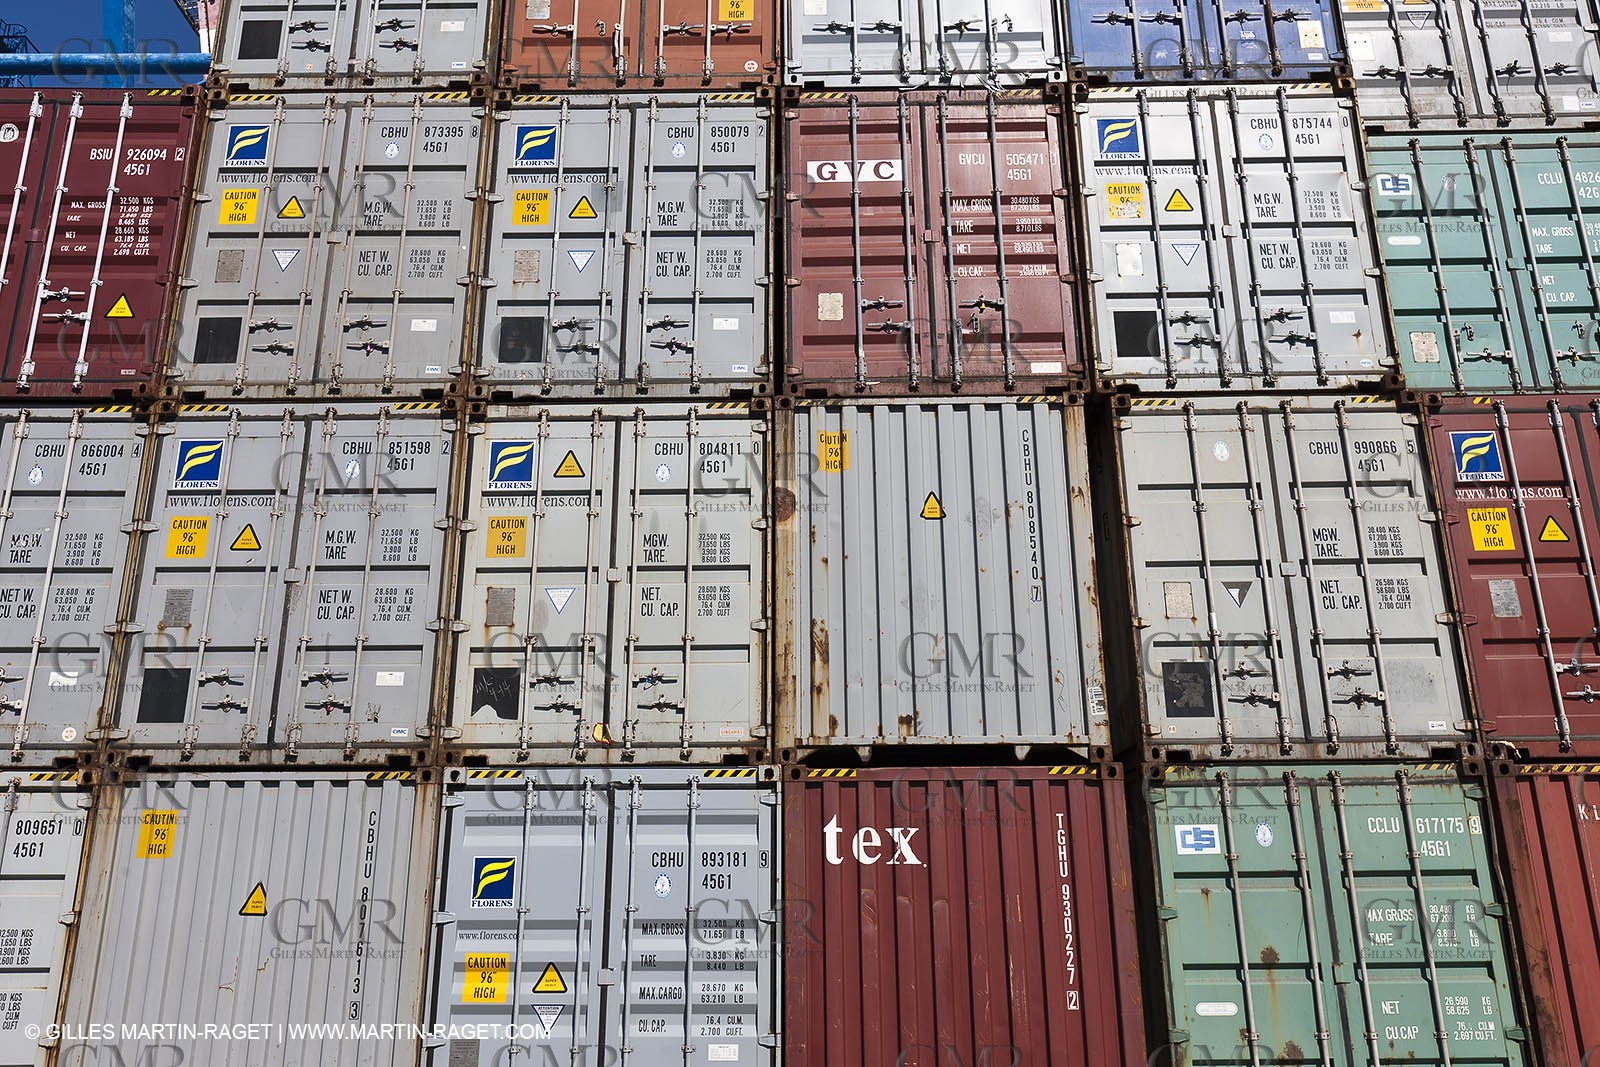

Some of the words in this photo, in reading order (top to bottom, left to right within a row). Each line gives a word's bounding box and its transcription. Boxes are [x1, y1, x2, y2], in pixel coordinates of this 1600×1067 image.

[1250, 119, 1278, 130] CBHU
[1292, 118, 1332, 129] 875744
[381, 127, 408, 138] CBHU
[424, 127, 464, 137] 873395
[668, 127, 693, 138] CBHU
[711, 126, 749, 137] 850079
[1296, 134, 1320, 144] 45G1
[423, 142, 448, 152] 45G1
[711, 142, 735, 153] 45G1
[90, 149, 112, 160] BSIU
[126, 149, 167, 160] 926094
[176, 148, 184, 161] 2
[959, 153, 985, 165] GVCU
[1006, 154, 1044, 165] 505471
[124, 164, 150, 175] 45G1
[816, 162, 895, 180] GVC
[1007, 169, 1032, 180] 45G1
[1538, 173, 1562, 184] CCLU
[225, 192, 256, 200] CAUTION
[1108, 186, 1140, 195] CAUTION
[516, 193, 548, 201] CAUTION
[1254, 193, 1283, 204] M.G.W.
[364, 202, 392, 213] M.G.W.
[658, 202, 685, 213] M.G.W.
[971, 199, 992, 211] GROSS
[229, 213, 246, 221] HIGH
[522, 214, 539, 223] HIGH
[1256, 207, 1277, 218] TARE
[364, 215, 383, 226] TARE
[658, 215, 677, 226] TARE
[956, 220, 973, 233] TARE
[957, 244, 971, 254] NET
[1260, 244, 1278, 256] NET
[1280, 244, 1292, 256] W.
[1536, 245, 1552, 253] TARE
[359, 251, 379, 262] NET
[379, 251, 390, 262] W.
[657, 252, 675, 263] NET
[676, 252, 687, 263] W.
[1542, 276, 1554, 285] NET
[35, 445, 65, 457] CBHU
[81, 445, 124, 457] 866004
[133, 444, 140, 457] 4
[343, 442, 371, 454] CBHU
[389, 441, 430, 454] 851598
[442, 440, 449, 454] 2
[654, 443, 683, 455] CBHU
[699, 442, 741, 455] 804811
[1309, 442, 1338, 455] CBHU
[1354, 441, 1397, 453] 990866
[79, 463, 107, 475] 45G1
[387, 459, 415, 470] 45G1
[700, 461, 727, 473] 45G1
[1358, 459, 1385, 472] 45G1
[1022, 430, 1032, 485] CBHU
[1027, 491, 1038, 580] 808540
[1471, 512, 1506, 521] CAUTION
[173, 520, 207, 529] CAUTION
[491, 519, 525, 529] CAUTION
[326, 531, 356, 543] M.G.W.
[644, 534, 668, 547] MGW.
[1312, 529, 1340, 541] MGW.
[1484, 538, 1504, 546] HIGH
[176, 545, 196, 555] HIGH
[325, 547, 346, 559] TARE
[496, 545, 516, 554] HIGH
[1315, 545, 1342, 556] TARE.
[644, 550, 667, 563] TARE.
[1320, 580, 1342, 593] NET.
[319, 591, 339, 603] NET
[341, 591, 352, 603] W.
[641, 587, 662, 601] NET.
[317, 606, 333, 620] CU.
[336, 606, 355, 620] CAP.
[16, 820, 63, 835] 809651
[1368, 817, 1399, 833] CCLU
[1416, 818, 1463, 833] 617175
[1472, 816, 1481, 834] 9
[13, 842, 44, 857] 45G1
[364, 811, 376, 879] CBHU
[1420, 841, 1451, 856] 45G1
[652, 853, 684, 867] CBHU
[702, 852, 747, 867] 893181
[761, 852, 767, 867] 9
[702, 874, 732, 889] 45G1
[1056, 813, 1068, 877] TGHU
[1062, 884, 1074, 984] 930227
[1068, 992, 1078, 1009] 2
[353, 887, 368, 995] 807613
[459, 931, 524, 940] www.florens.co
[1369, 933, 1393, 946] TARE
[468, 957, 506, 968] CAUTION
[640, 955, 656, 967] TARE
[474, 987, 495, 998] HIGH
[734, 995, 744, 1003] LB
[1482, 997, 1491, 1005] KG
[350, 1002, 359, 1019] 3
[1382, 1001, 1399, 1014] NET
